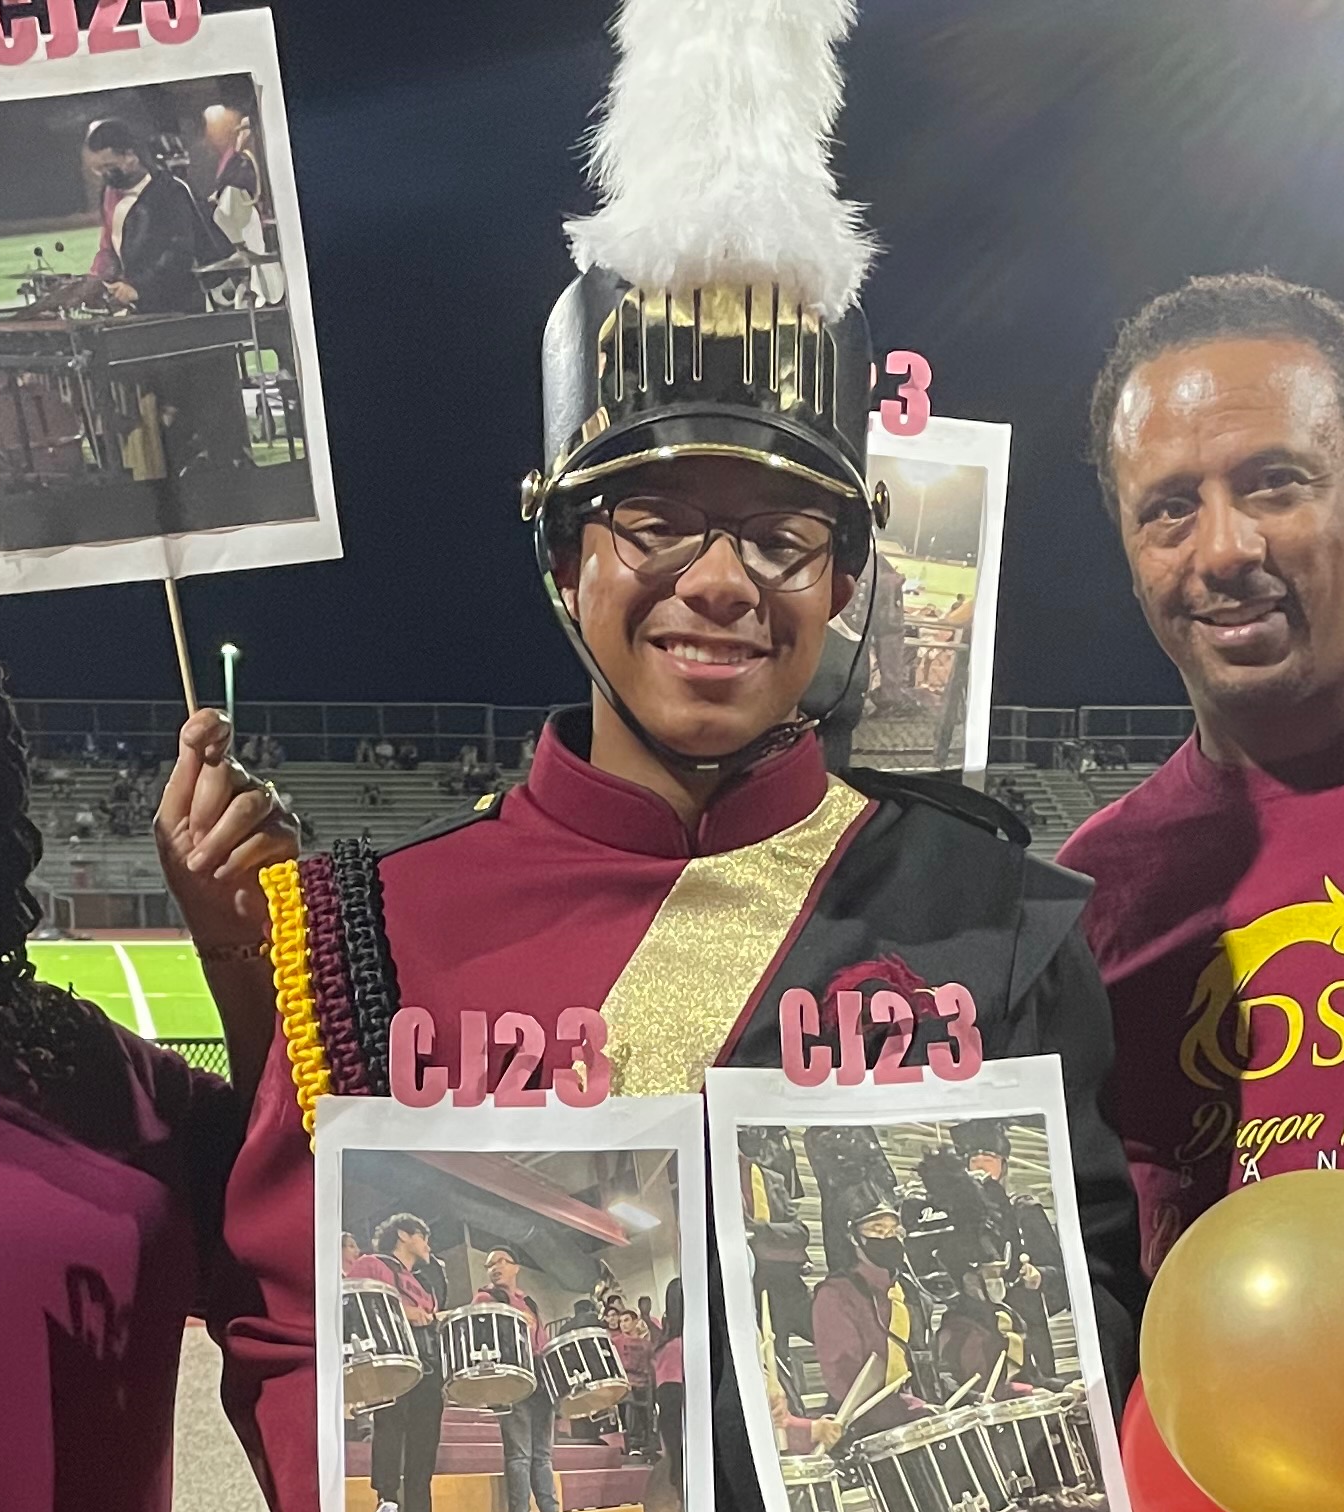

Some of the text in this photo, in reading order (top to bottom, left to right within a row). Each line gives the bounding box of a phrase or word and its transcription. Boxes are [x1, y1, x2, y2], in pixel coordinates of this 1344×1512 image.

[870, 350, 932, 436] 3
[389, 1006, 612, 1108] CJ23
[779, 982, 983, 1087] CJ23
